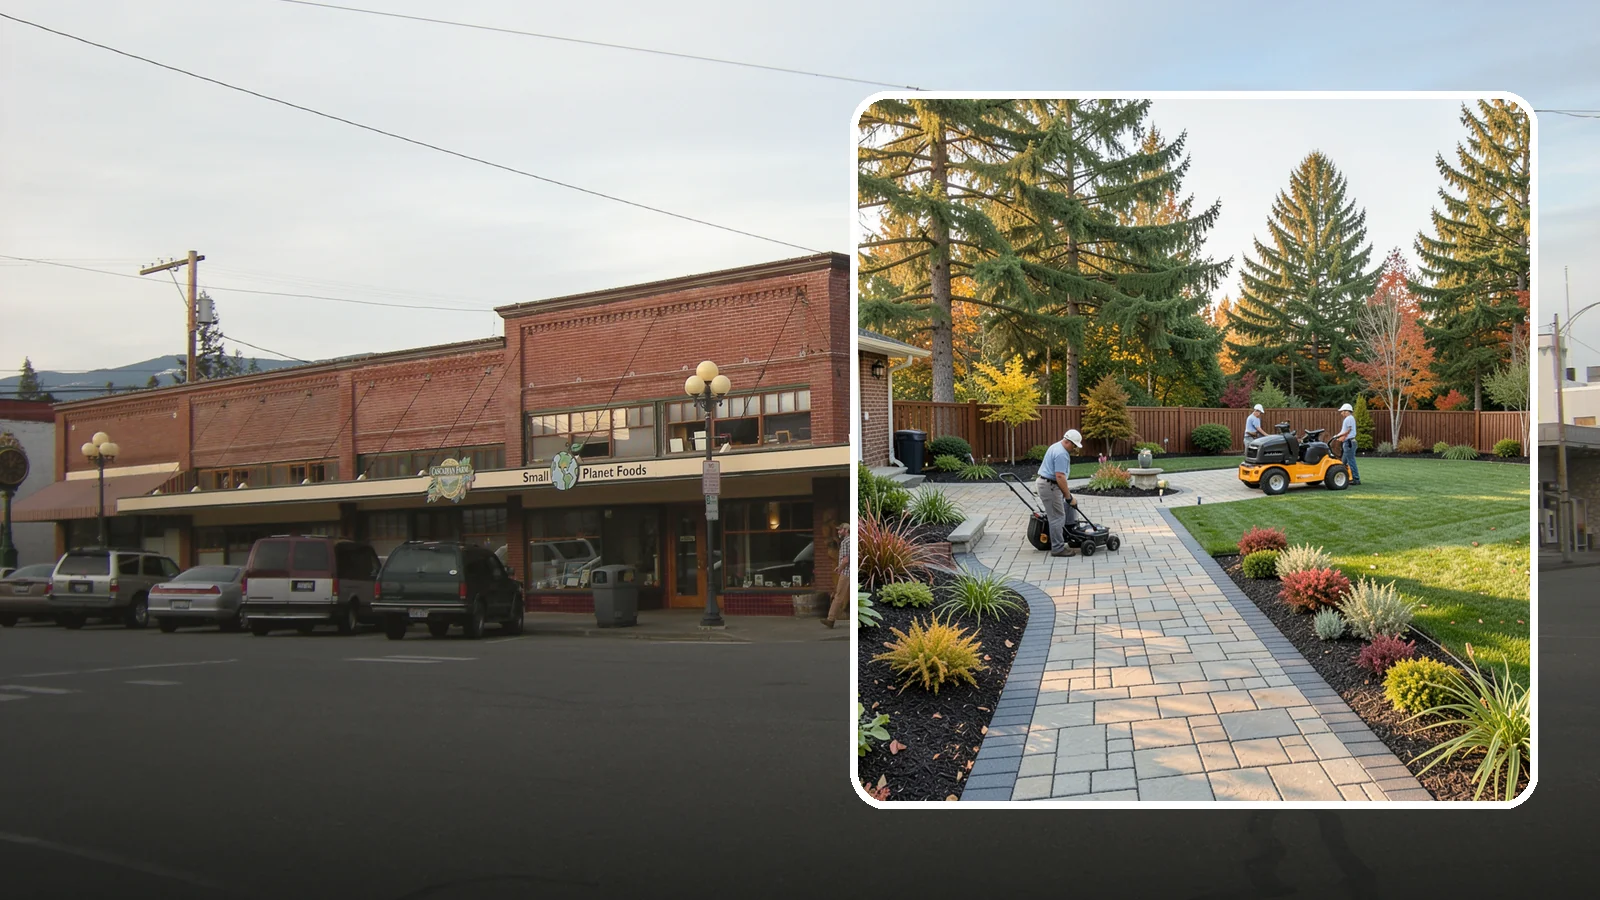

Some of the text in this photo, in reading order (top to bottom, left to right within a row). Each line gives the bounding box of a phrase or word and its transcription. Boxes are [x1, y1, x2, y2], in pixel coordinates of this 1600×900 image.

[523, 464, 647, 483] Small Planet Foods
